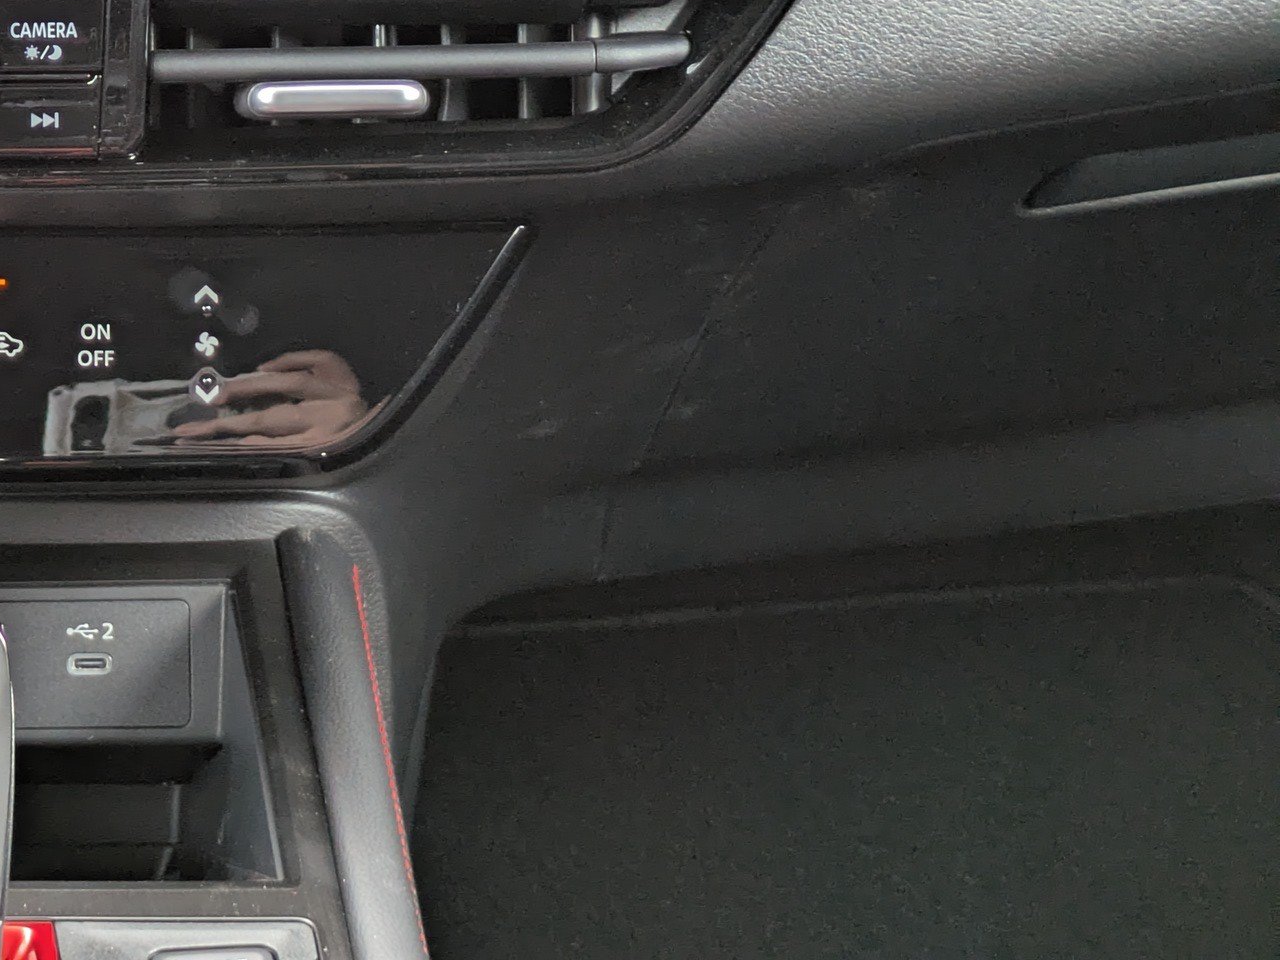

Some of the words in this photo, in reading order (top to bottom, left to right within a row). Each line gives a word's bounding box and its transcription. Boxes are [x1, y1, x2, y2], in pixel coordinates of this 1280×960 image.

[10, 21, 78, 39] CAMERA
[80, 323, 111, 341] ON
[77, 349, 115, 367] OFF
[102, 622, 114, 640] 2
